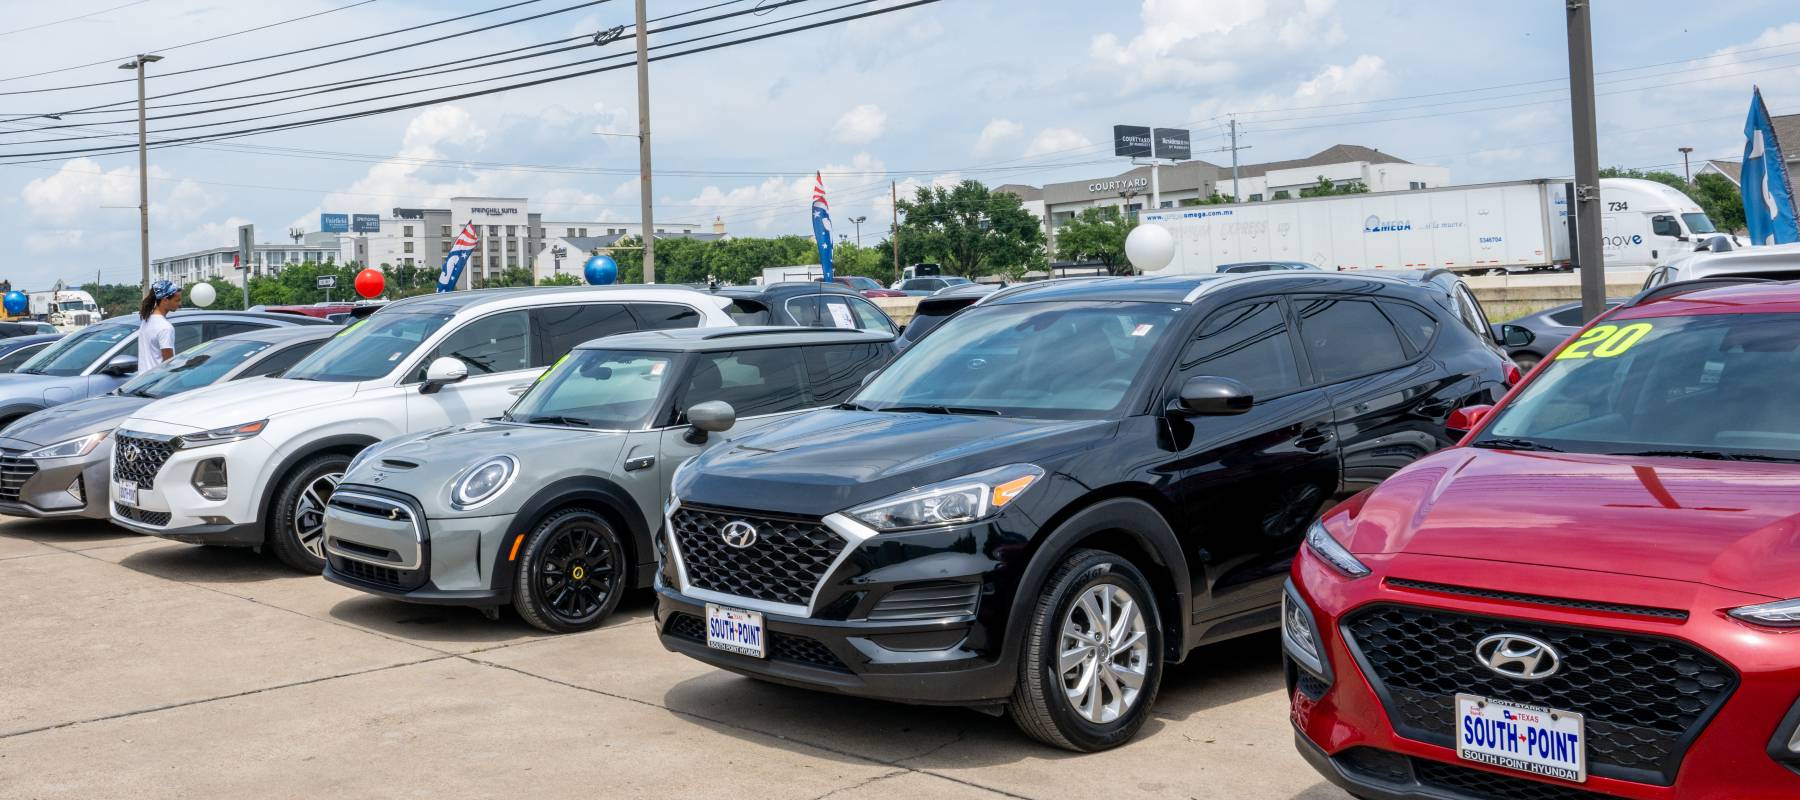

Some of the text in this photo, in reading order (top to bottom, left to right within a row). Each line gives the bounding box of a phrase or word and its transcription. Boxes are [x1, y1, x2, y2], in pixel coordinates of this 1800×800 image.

[1089, 178, 1148, 192] COURTYARD
[1608, 202, 1628, 211] 734
[1555, 323, 1653, 360] 20
[1517, 713, 1539, 724] TEXAS
[1464, 715, 1578, 764] SOUTH POINT
[1464, 749, 1577, 781] SOUTH POINT HYUNDAI
